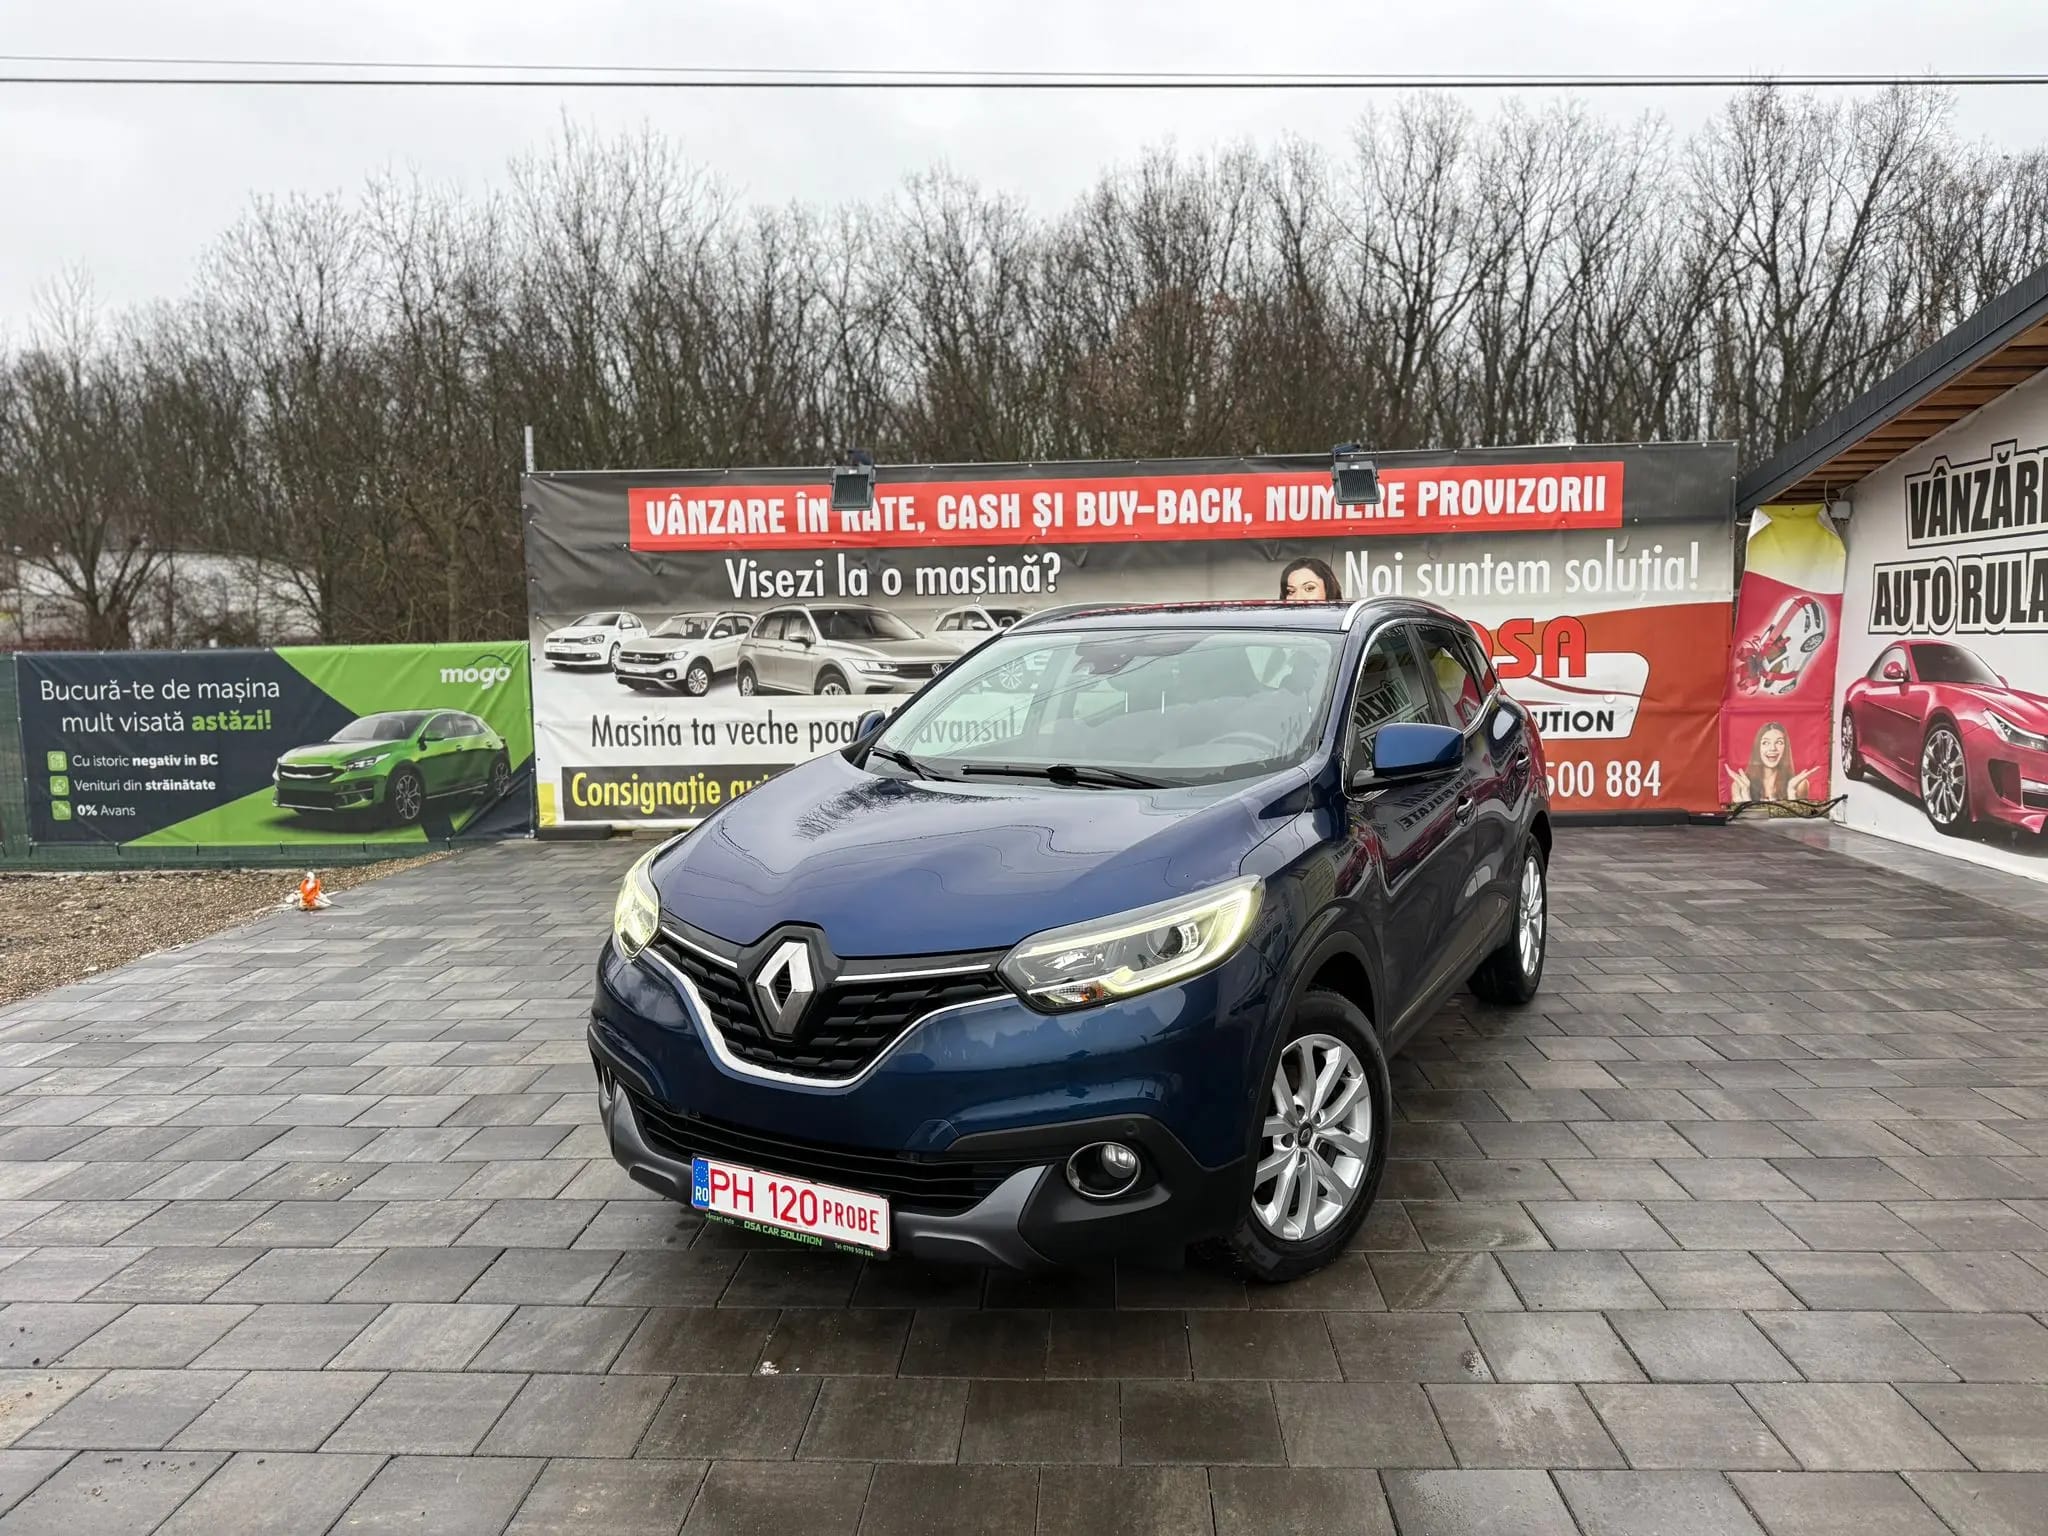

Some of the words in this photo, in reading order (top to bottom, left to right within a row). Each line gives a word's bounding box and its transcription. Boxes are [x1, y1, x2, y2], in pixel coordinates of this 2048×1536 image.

[645, 493, 786, 536] VÂNZARE
[796, 491, 830, 533] ÎN
[937, 493, 1021, 530] CASH
[1032, 492, 1064, 537] ȘI
[1076, 487, 1253, 527] BUY-BACK,
[1417, 475, 1607, 517] PROVIZORII
[725, 558, 825, 599] Visezi
[837, 553, 868, 597] la
[881, 567, 902, 597] o
[915, 551, 1061, 604] mașină?
[1345, 550, 1404, 599] Noi
[1416, 553, 1551, 597] suntem
[1565, 538, 1699, 602] soluția!
[1873, 566, 1951, 626] AUTO
[40, 679, 155, 701] Bucură-te
[161, 679, 191, 700] de
[198, 678, 281, 704] mașina
[440, 667, 511, 690] mogo
[62, 712, 115, 732] mult
[119, 711, 185, 732] visată
[191, 709, 272, 731] astăzi!
[690, 717, 716, 746] ta
[725, 709, 799, 747] veche
[72, 755, 91, 767] Cu
[93, 754, 130, 767] istoric
[132, 754, 182, 769] negativ
[200, 754, 219, 766] BC
[73, 779, 121, 791] Venituri
[123, 778, 142, 791] din
[145, 778, 216, 791] străinătate
[571, 771, 721, 814] Consignație
[1606, 760, 1661, 797] 884
[77, 804, 98, 817] 0%
[100, 804, 136, 817] Avans
[695, 1185, 709, 1202] RO
[710, 1168, 754, 1213] PH
[768, 1181, 818, 1226] 120
[823, 1199, 880, 1234] PROBE
[762, 1225, 780, 1237] CAR
[780, 1230, 823, 1247] SOLUTION
